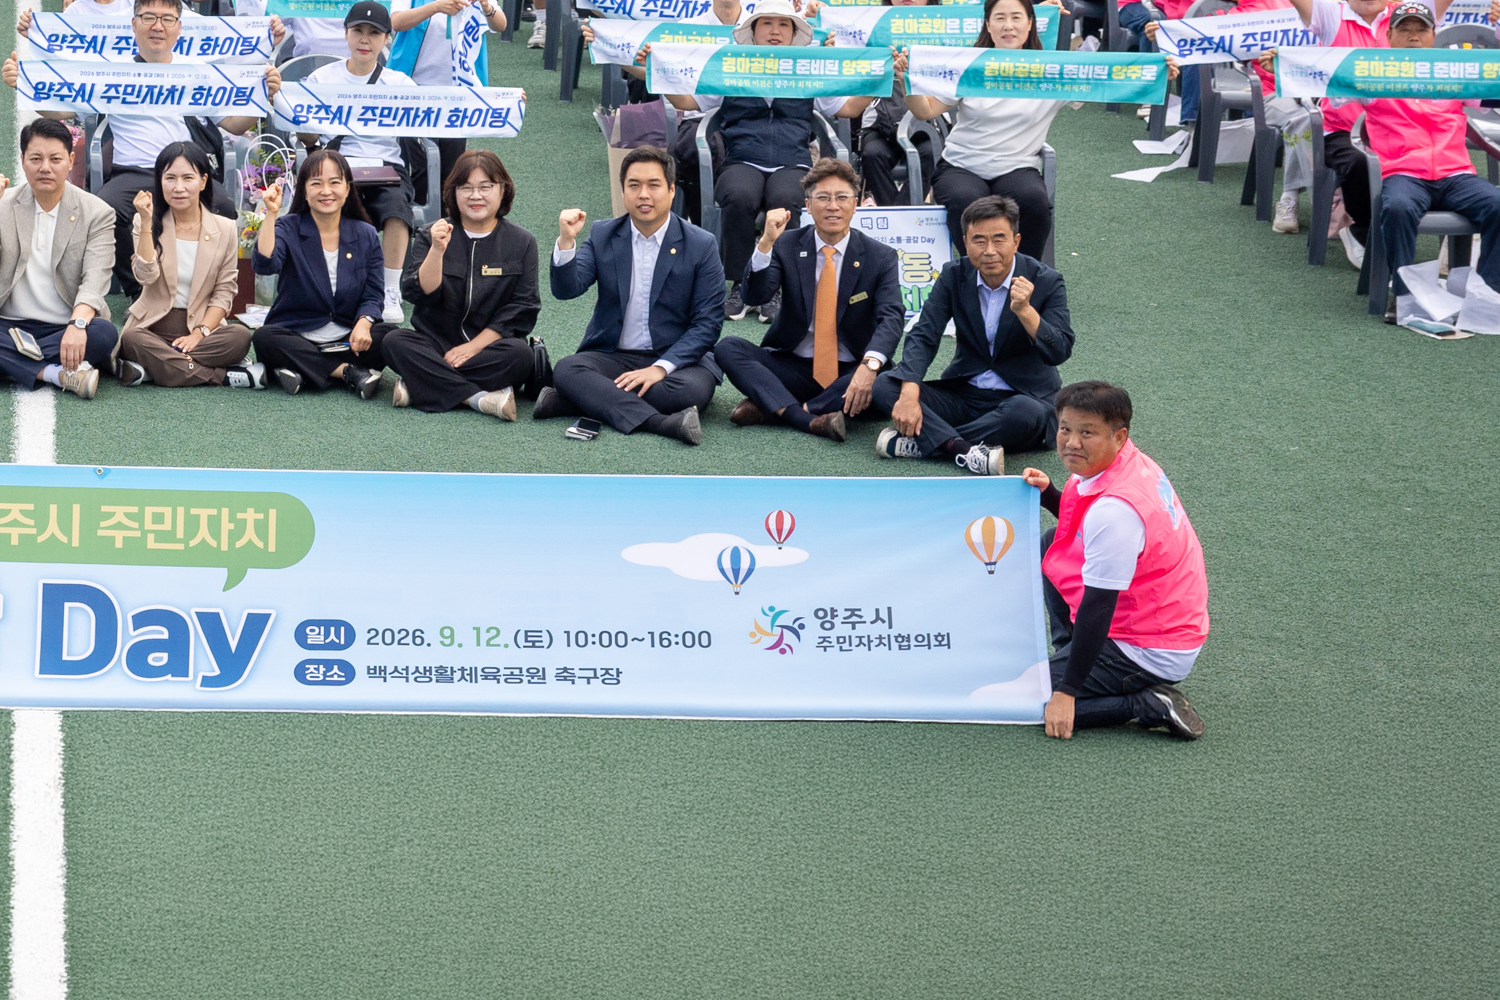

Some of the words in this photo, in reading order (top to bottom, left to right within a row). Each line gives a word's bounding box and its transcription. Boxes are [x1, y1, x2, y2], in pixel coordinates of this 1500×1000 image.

[47, 33, 108, 53] 양주시
[199, 36, 260, 56] 화이팅
[722, 56, 793, 75] 경마공원은
[796, 58, 839, 75] 준비된
[842, 59, 885, 75] 양주로
[984, 61, 1059, 78] 경마공원은
[1063, 64, 1109, 79] 준비된
[1112, 65, 1157, 81] 양주로
[1354, 61, 1430, 78] 경마공원은
[1433, 62, 1480, 78] 준비된
[34, 81, 95, 103] 양주시
[100, 85, 184, 106] 주민자치
[189, 86, 255, 107] 화이팅
[723, 79, 750, 87] 경마공원
[775, 80, 796, 88] 양주가
[984, 81, 1013, 90] 경마공원
[1039, 83, 1061, 91] 양주가
[294, 104, 350, 125] 양주시
[357, 106, 441, 127] 주민자치
[444, 107, 510, 129] 화이팅
[95, 504, 278, 555] 주민자치
[813, 606, 893, 631] 양주시
[36, 580, 278, 692] Day
[304, 624, 346, 646] 일시
[366, 627, 432, 648] 2026.
[439, 626, 463, 648] 9.
[563, 629, 712, 650] 10:00~16:00
[816, 632, 952, 653] 주민자치협의회
[304, 664, 346, 683] 장소
[366, 664, 547, 685] 백석생활체육공원
[555, 665, 623, 686] 축구장
